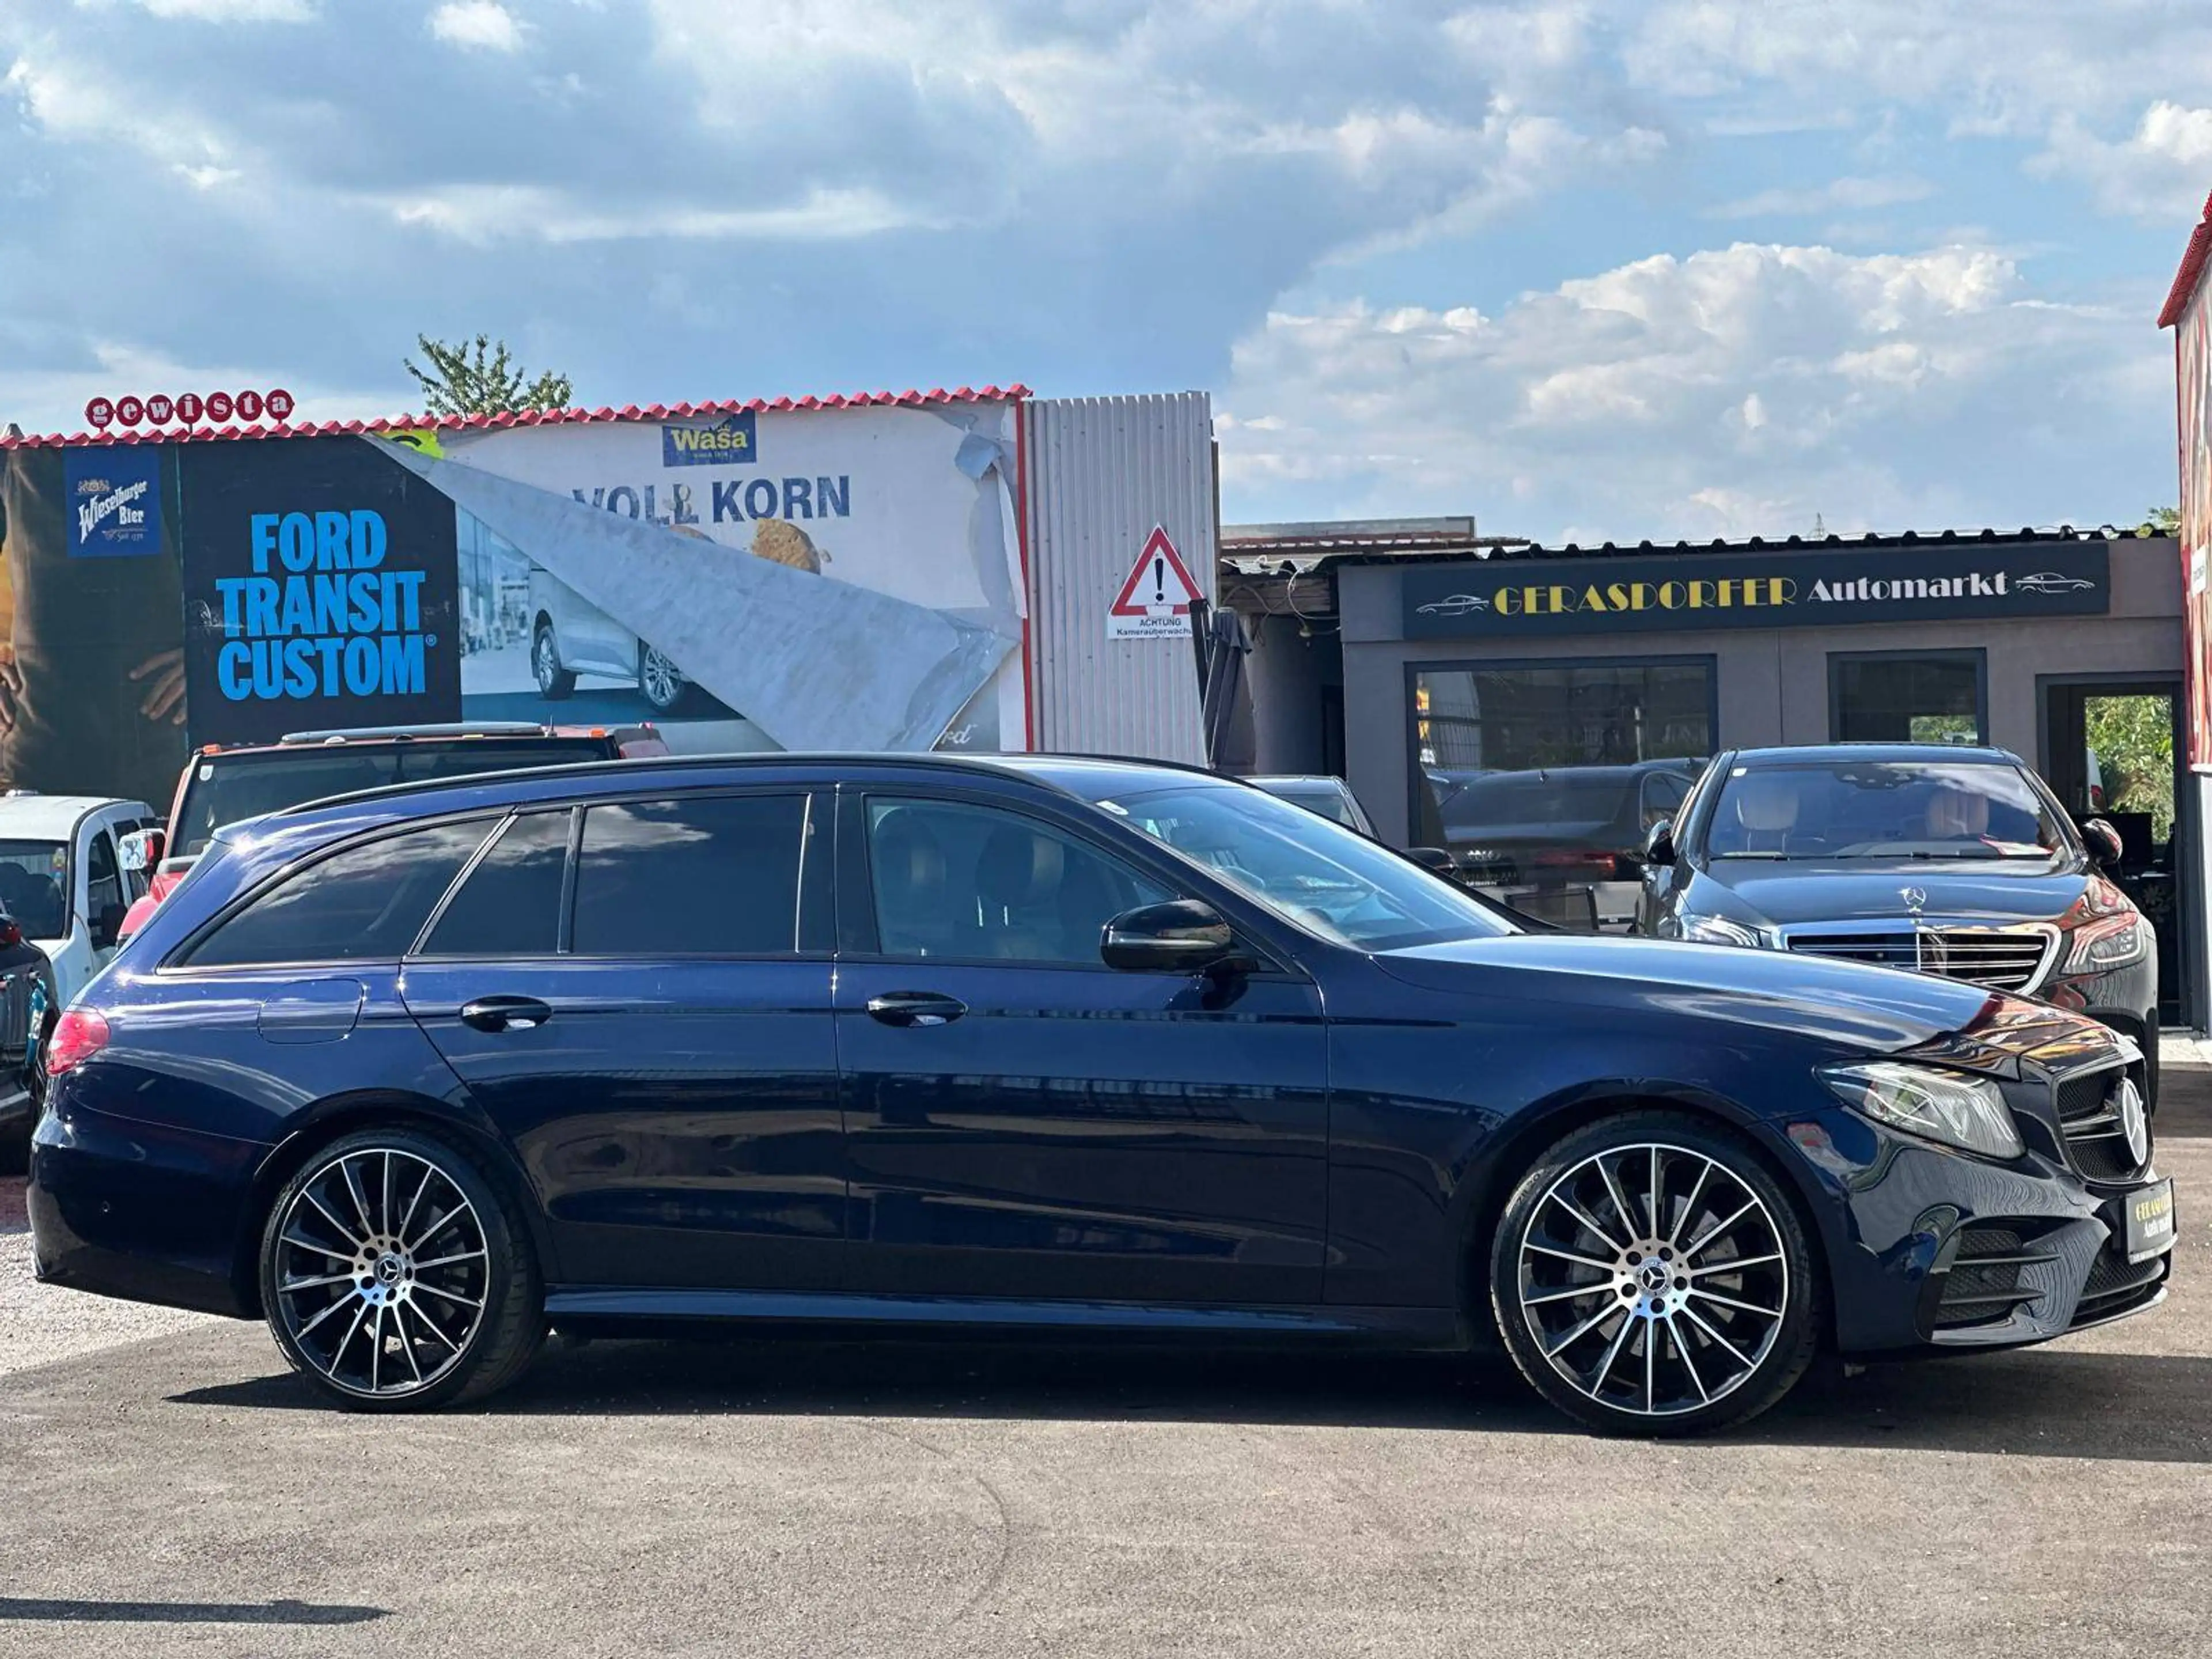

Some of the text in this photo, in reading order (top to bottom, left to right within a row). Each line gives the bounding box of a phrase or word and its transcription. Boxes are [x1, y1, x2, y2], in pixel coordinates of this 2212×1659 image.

[92, 393, 290, 423] gewista
[78, 480, 147, 544] Wieselburger
[119, 505, 144, 525] Bier
[712, 475, 850, 523] KORN
[251, 510, 387, 573] FORD
[215, 571, 426, 638] TRANSIT
[1494, 571, 2009, 615] GERASDORFER Automarkt
[1139, 618, 1181, 627] ACHTUNG
